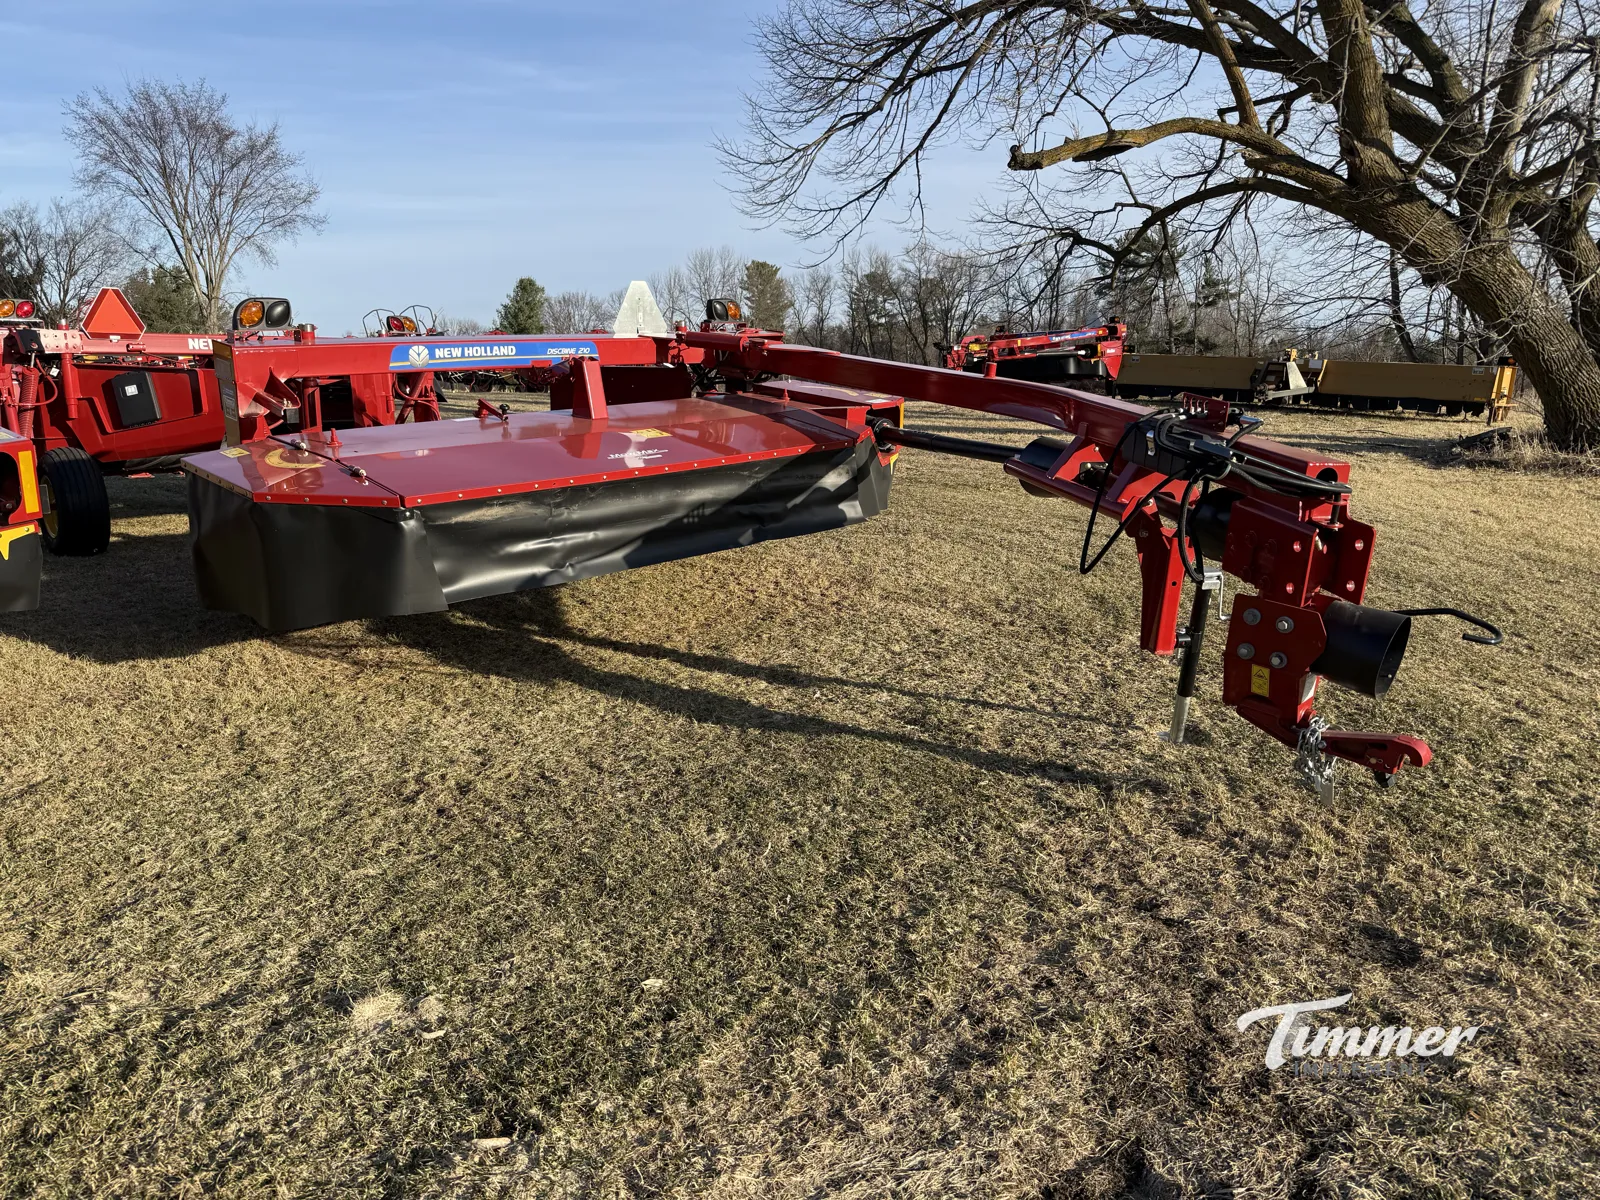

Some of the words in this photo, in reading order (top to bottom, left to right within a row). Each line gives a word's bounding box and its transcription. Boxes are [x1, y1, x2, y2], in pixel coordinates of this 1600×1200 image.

[434, 347, 462, 359] NEW
[464, 345, 517, 357] HOLLAND
[547, 347, 577, 355] DISCBINE
